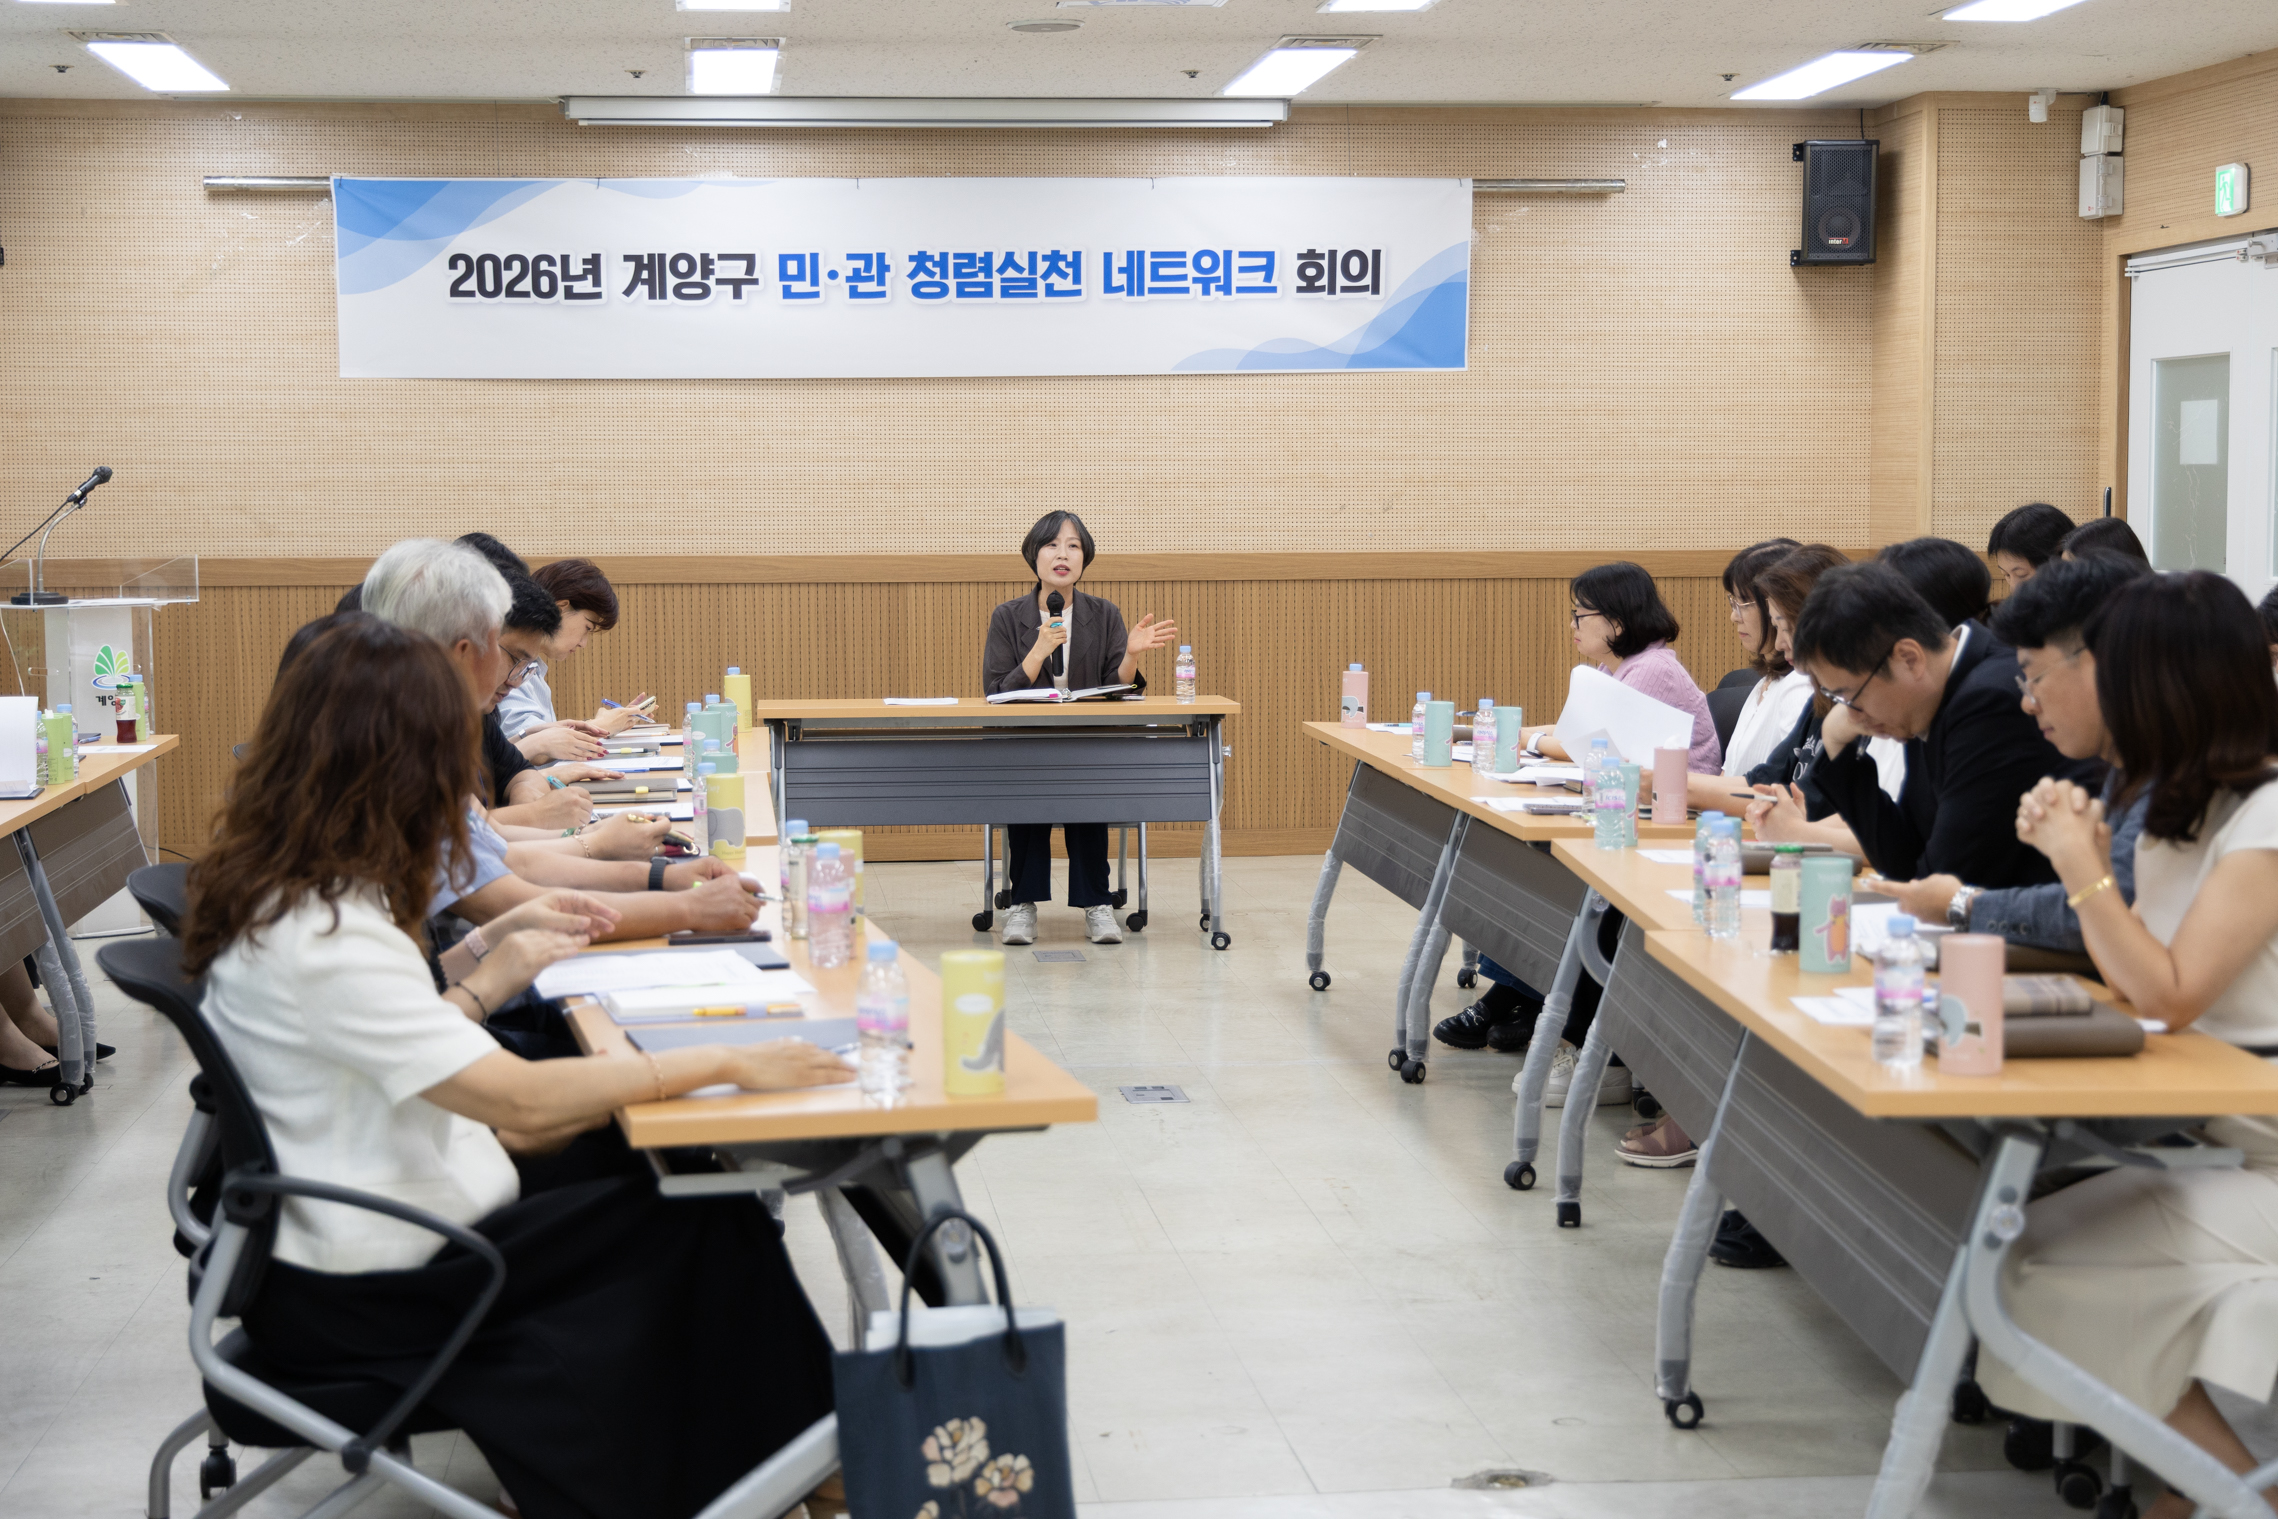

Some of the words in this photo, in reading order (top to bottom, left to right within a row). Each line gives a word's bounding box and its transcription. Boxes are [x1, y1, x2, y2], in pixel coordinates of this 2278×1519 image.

[448, 253, 602, 301] 2026년
[622, 252, 760, 301] 계양구
[778, 252, 891, 300] 민·관
[906, 249, 1082, 300] 청렴실천
[1103, 249, 1278, 297] 네트워크
[1296, 248, 1382, 296] 회의
